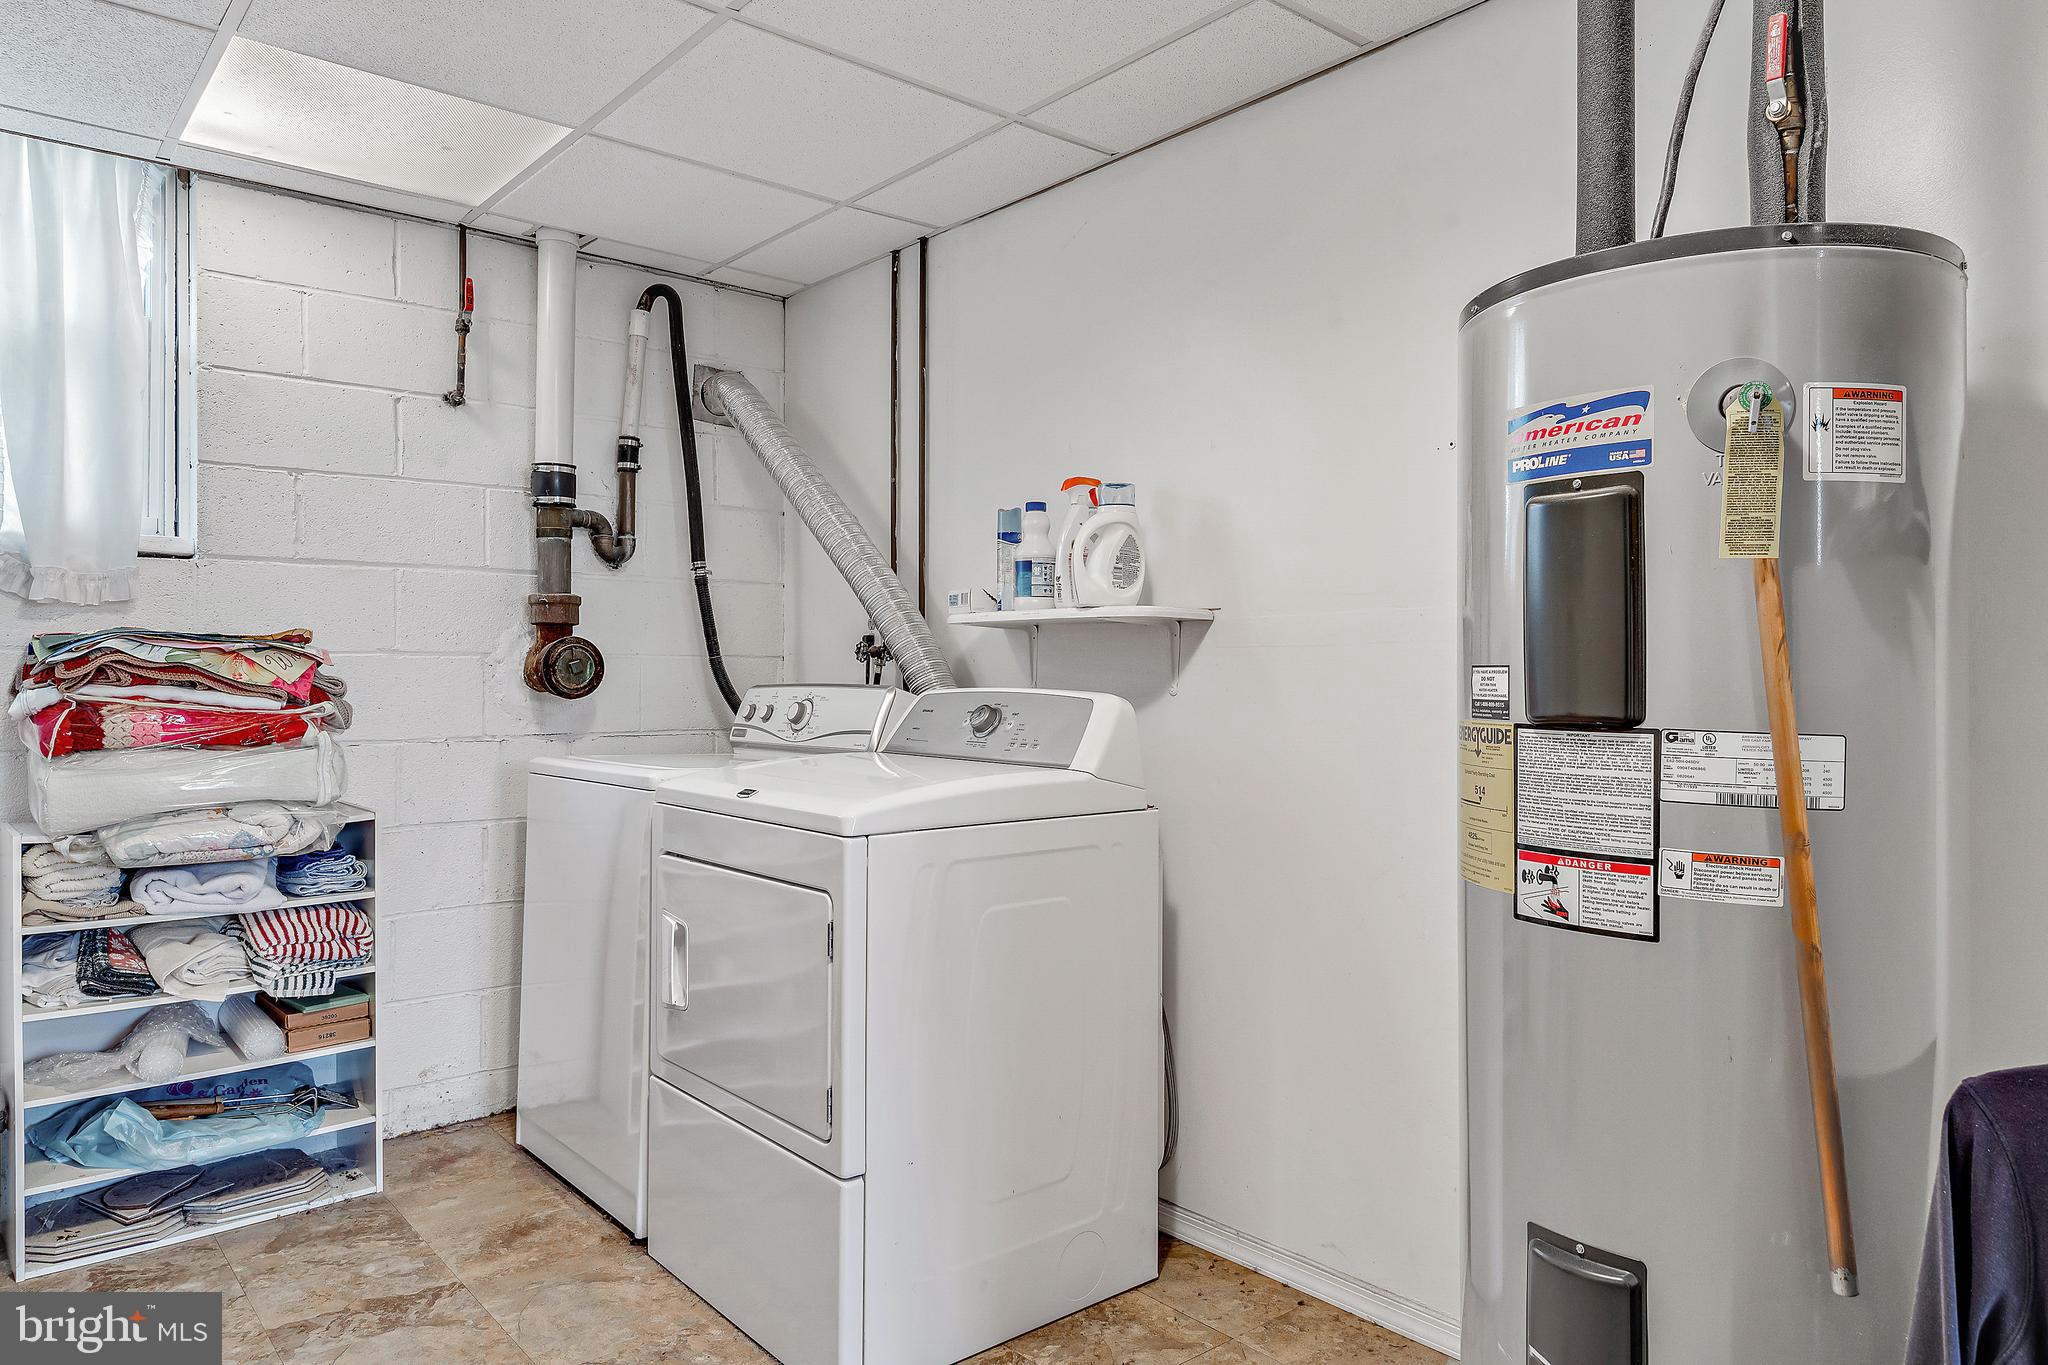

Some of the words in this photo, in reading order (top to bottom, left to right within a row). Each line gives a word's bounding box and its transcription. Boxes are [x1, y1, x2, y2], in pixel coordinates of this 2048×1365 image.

[1852, 390, 1894, 400] WARNING
[1510, 414, 1642, 442] merican
[1542, 436, 1578, 448] HEATER
[1584, 428, 1638, 440] COMPANY
[1512, 454, 1568, 473] PROLINE
[1609, 454, 1630, 462] USA
[1474, 784, 1486, 796] 514
[1566, 858, 1612, 871] DANGER
[1714, 856, 1768, 866] WARNING
[213, 1077, 268, 1096] Garden
